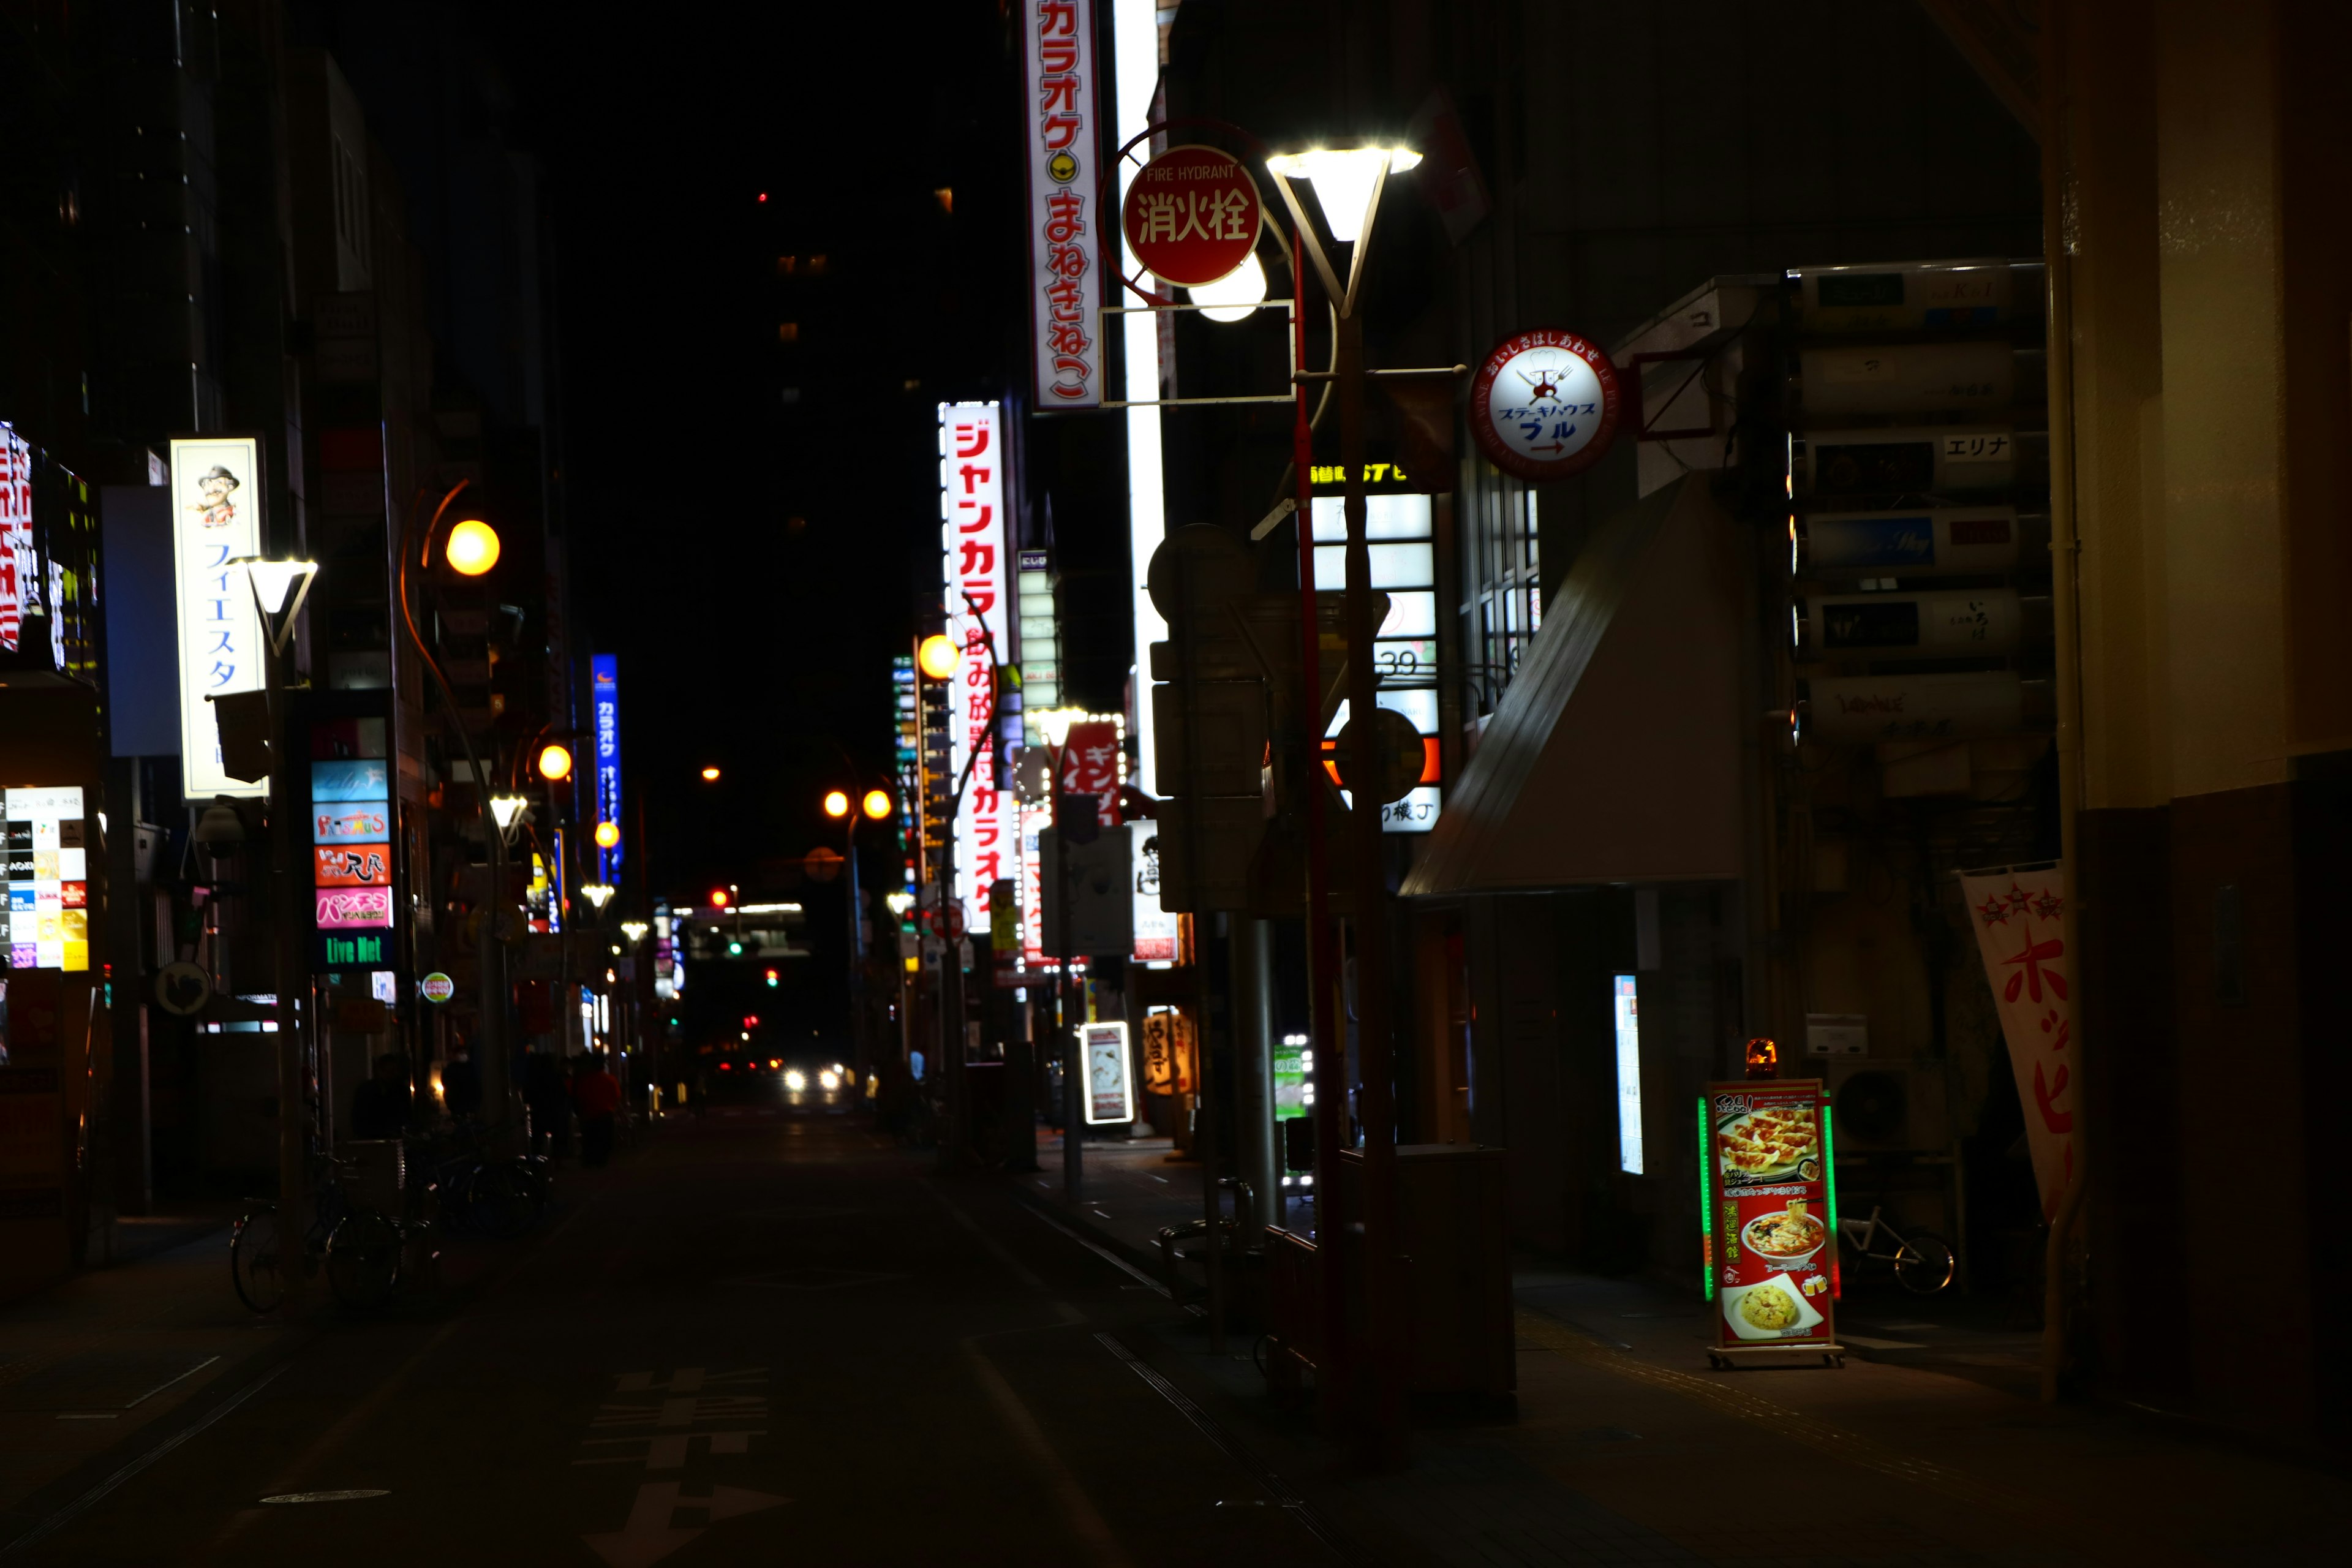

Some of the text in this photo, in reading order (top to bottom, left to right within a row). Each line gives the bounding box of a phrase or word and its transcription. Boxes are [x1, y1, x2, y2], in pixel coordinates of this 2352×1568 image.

[1038, 0, 1082, 151] カラオケ
[1147, 163, 1235, 181] FIRE HYDRANT
[1138, 187, 1250, 244] 消火栓
[1045, 187, 1092, 400] まねきねこ
[1486, 331, 1600, 377] おいしさはしあわせ
[1498, 402, 1597, 421] ステーキハウス
[1520, 417, 1577, 441] ブル
[1947, 437, 2008, 456] エリナ
[955, 418, 997, 616] ジャンカラ
[205, 543, 236, 689] フィエスタ
[1969, 601, 1989, 641] いろは
[326, 935, 382, 964] Live Net
